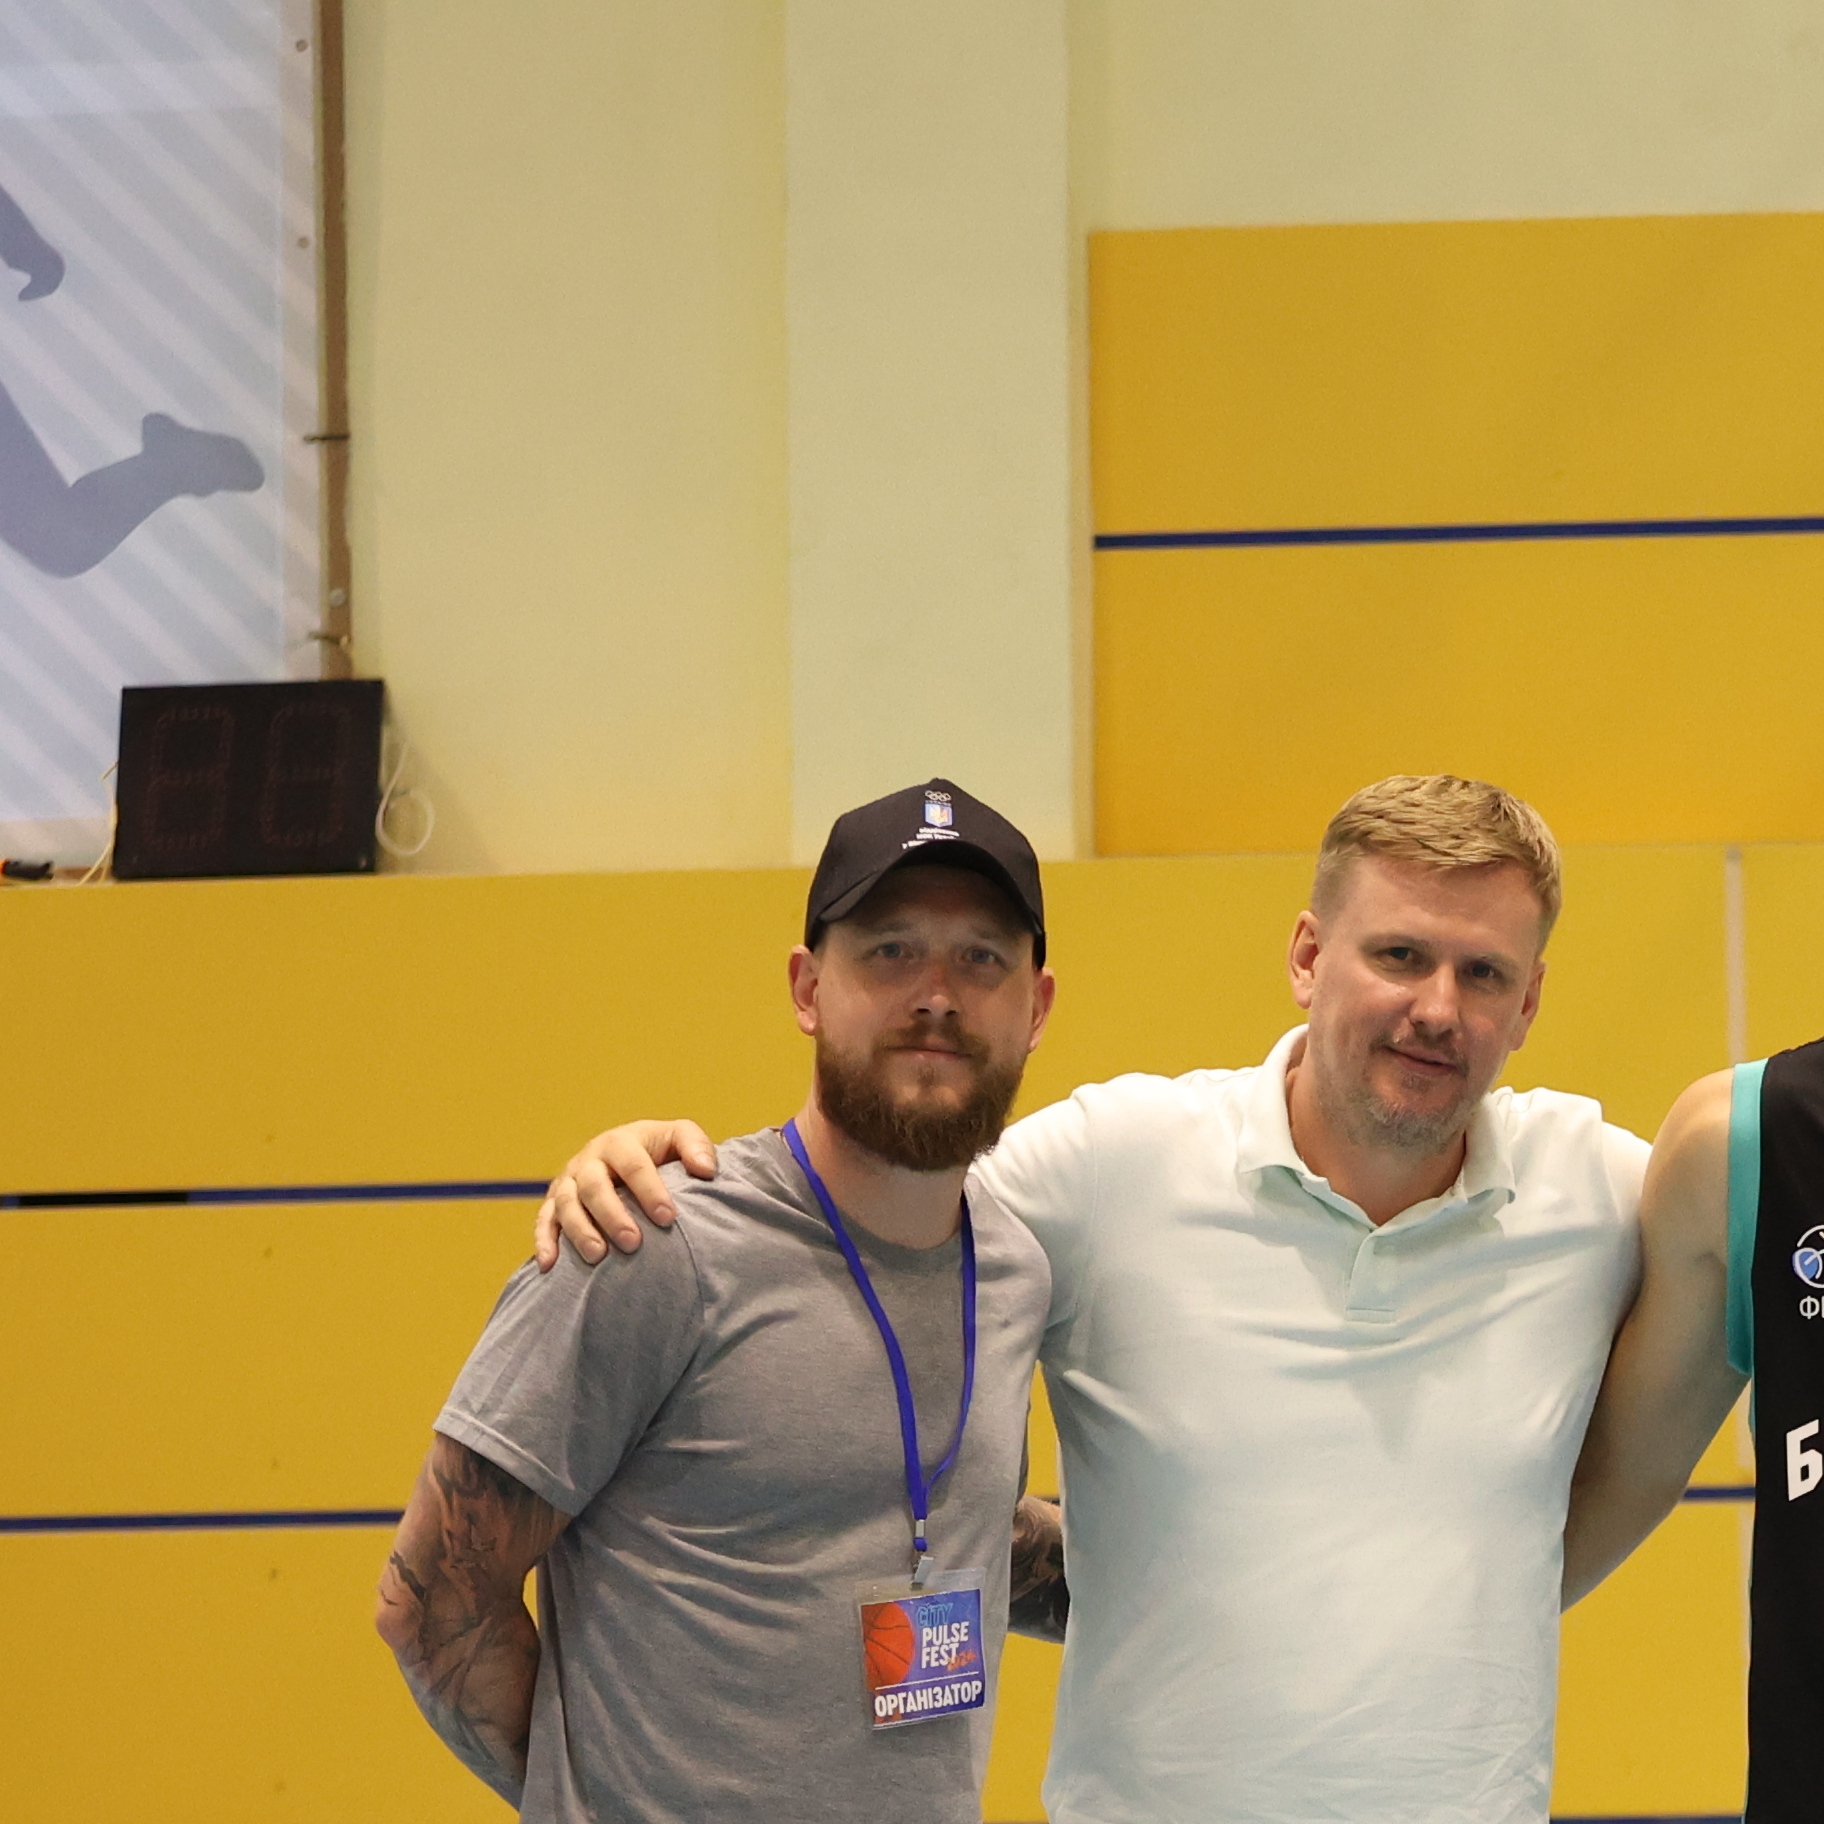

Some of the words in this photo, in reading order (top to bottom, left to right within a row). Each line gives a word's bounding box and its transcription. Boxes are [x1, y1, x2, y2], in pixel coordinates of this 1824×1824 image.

[922, 1620, 970, 1648] PULSE
[921, 1642, 960, 1669] FEST
[874, 1680, 983, 1718] ОРГАНІЗАТОР
